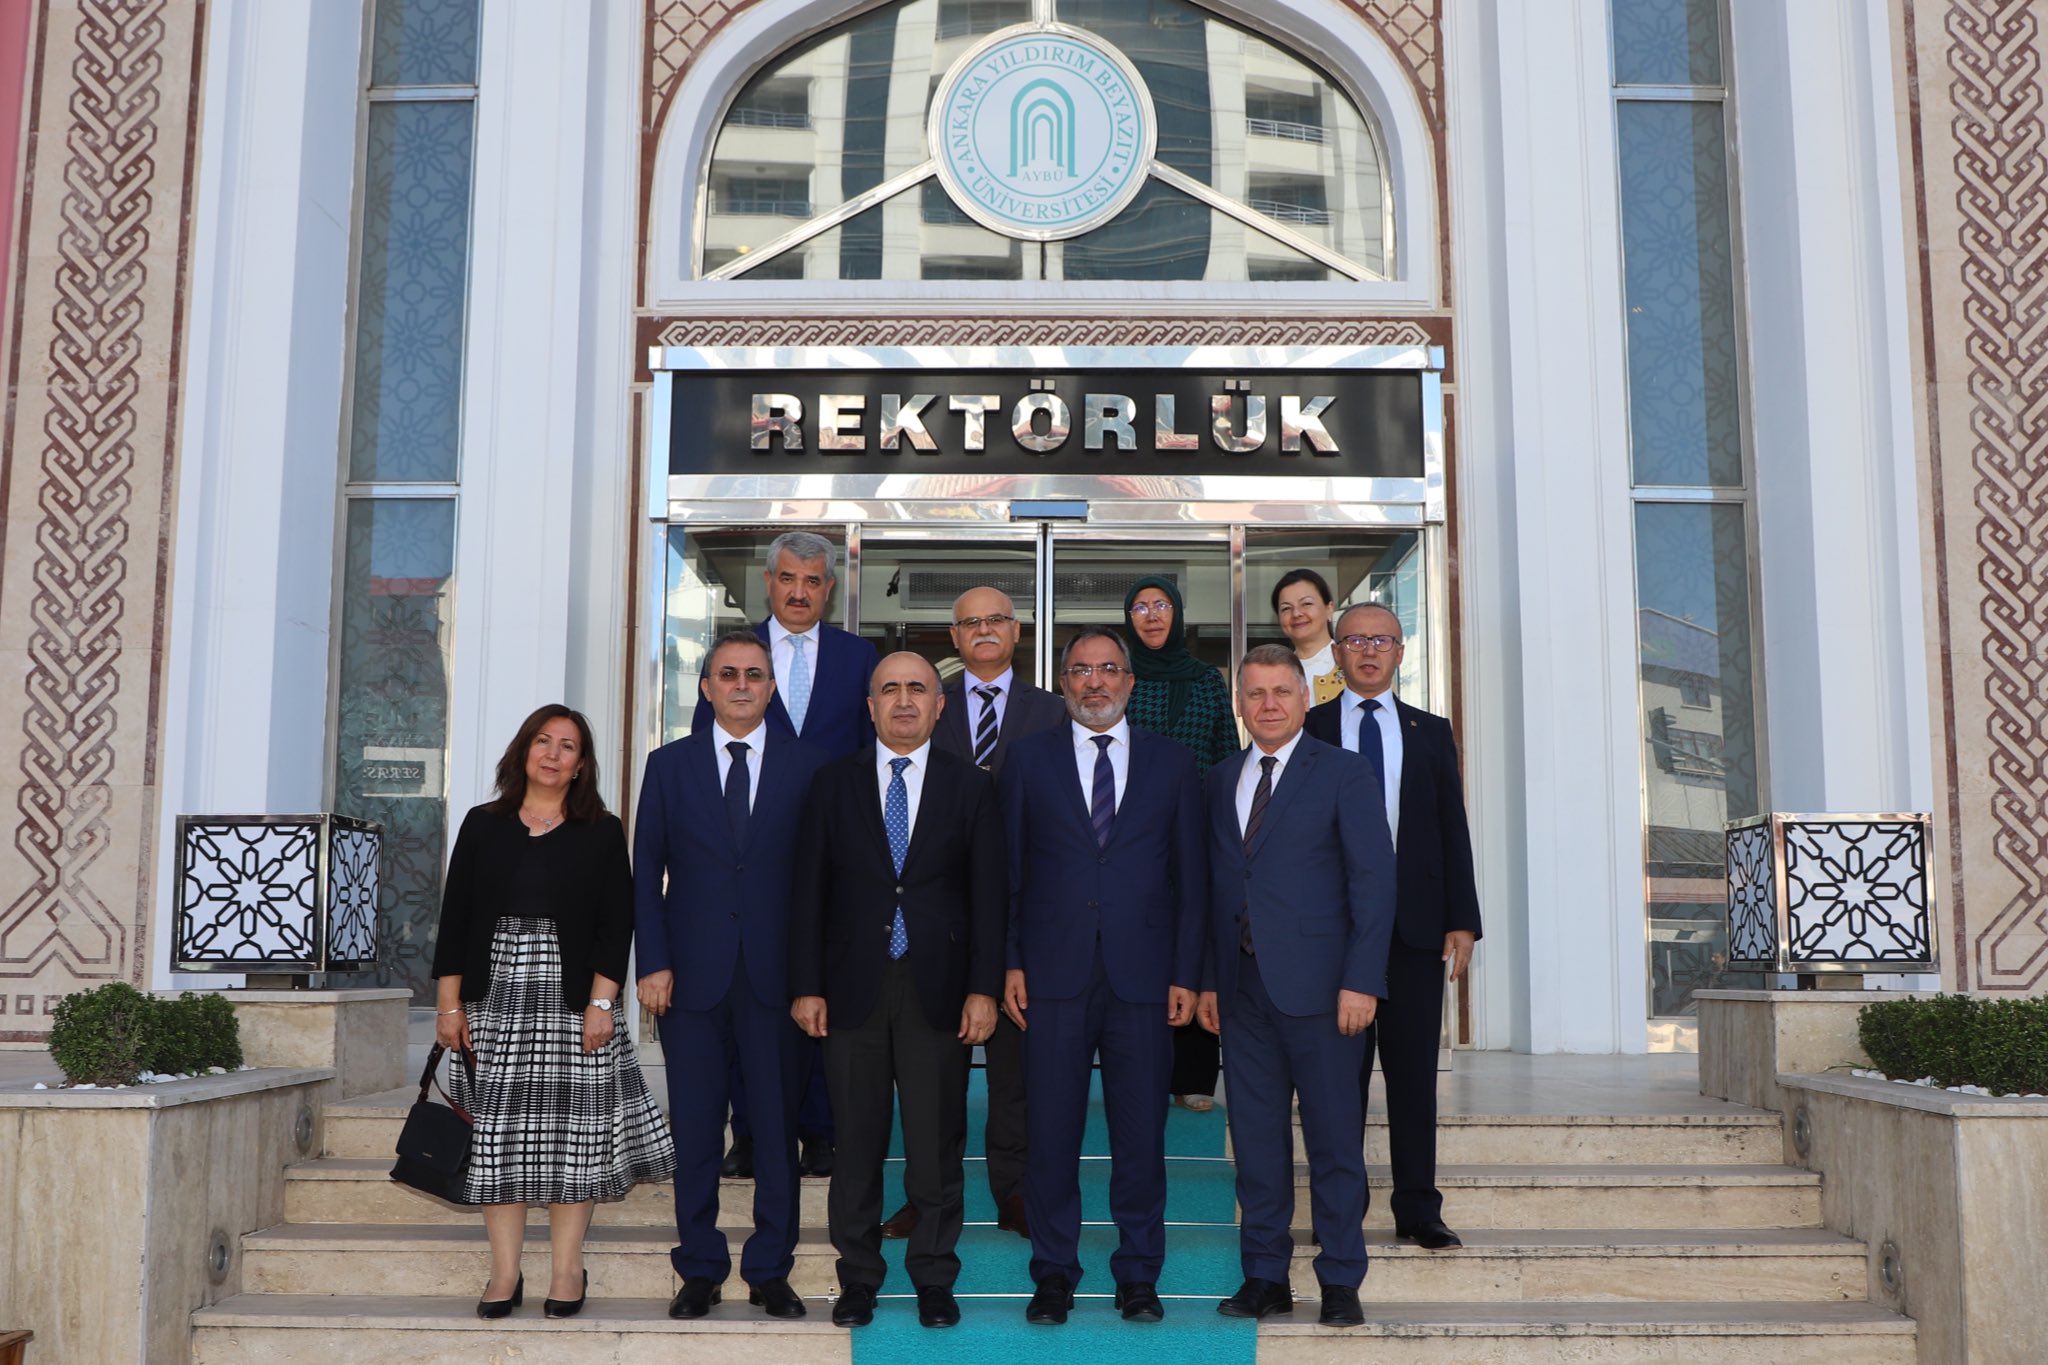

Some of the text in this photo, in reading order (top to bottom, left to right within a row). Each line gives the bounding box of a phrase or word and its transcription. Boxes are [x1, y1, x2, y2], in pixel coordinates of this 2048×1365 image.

[952, 46, 1134, 166] ANKARA YILDIRIM BEYAZIT
[971, 174, 1115, 220] ÜNİVERSİTESİ
[1021, 171, 1064, 182] AYBÜ
[750, 379, 1341, 454] REKTÖRLÜK
